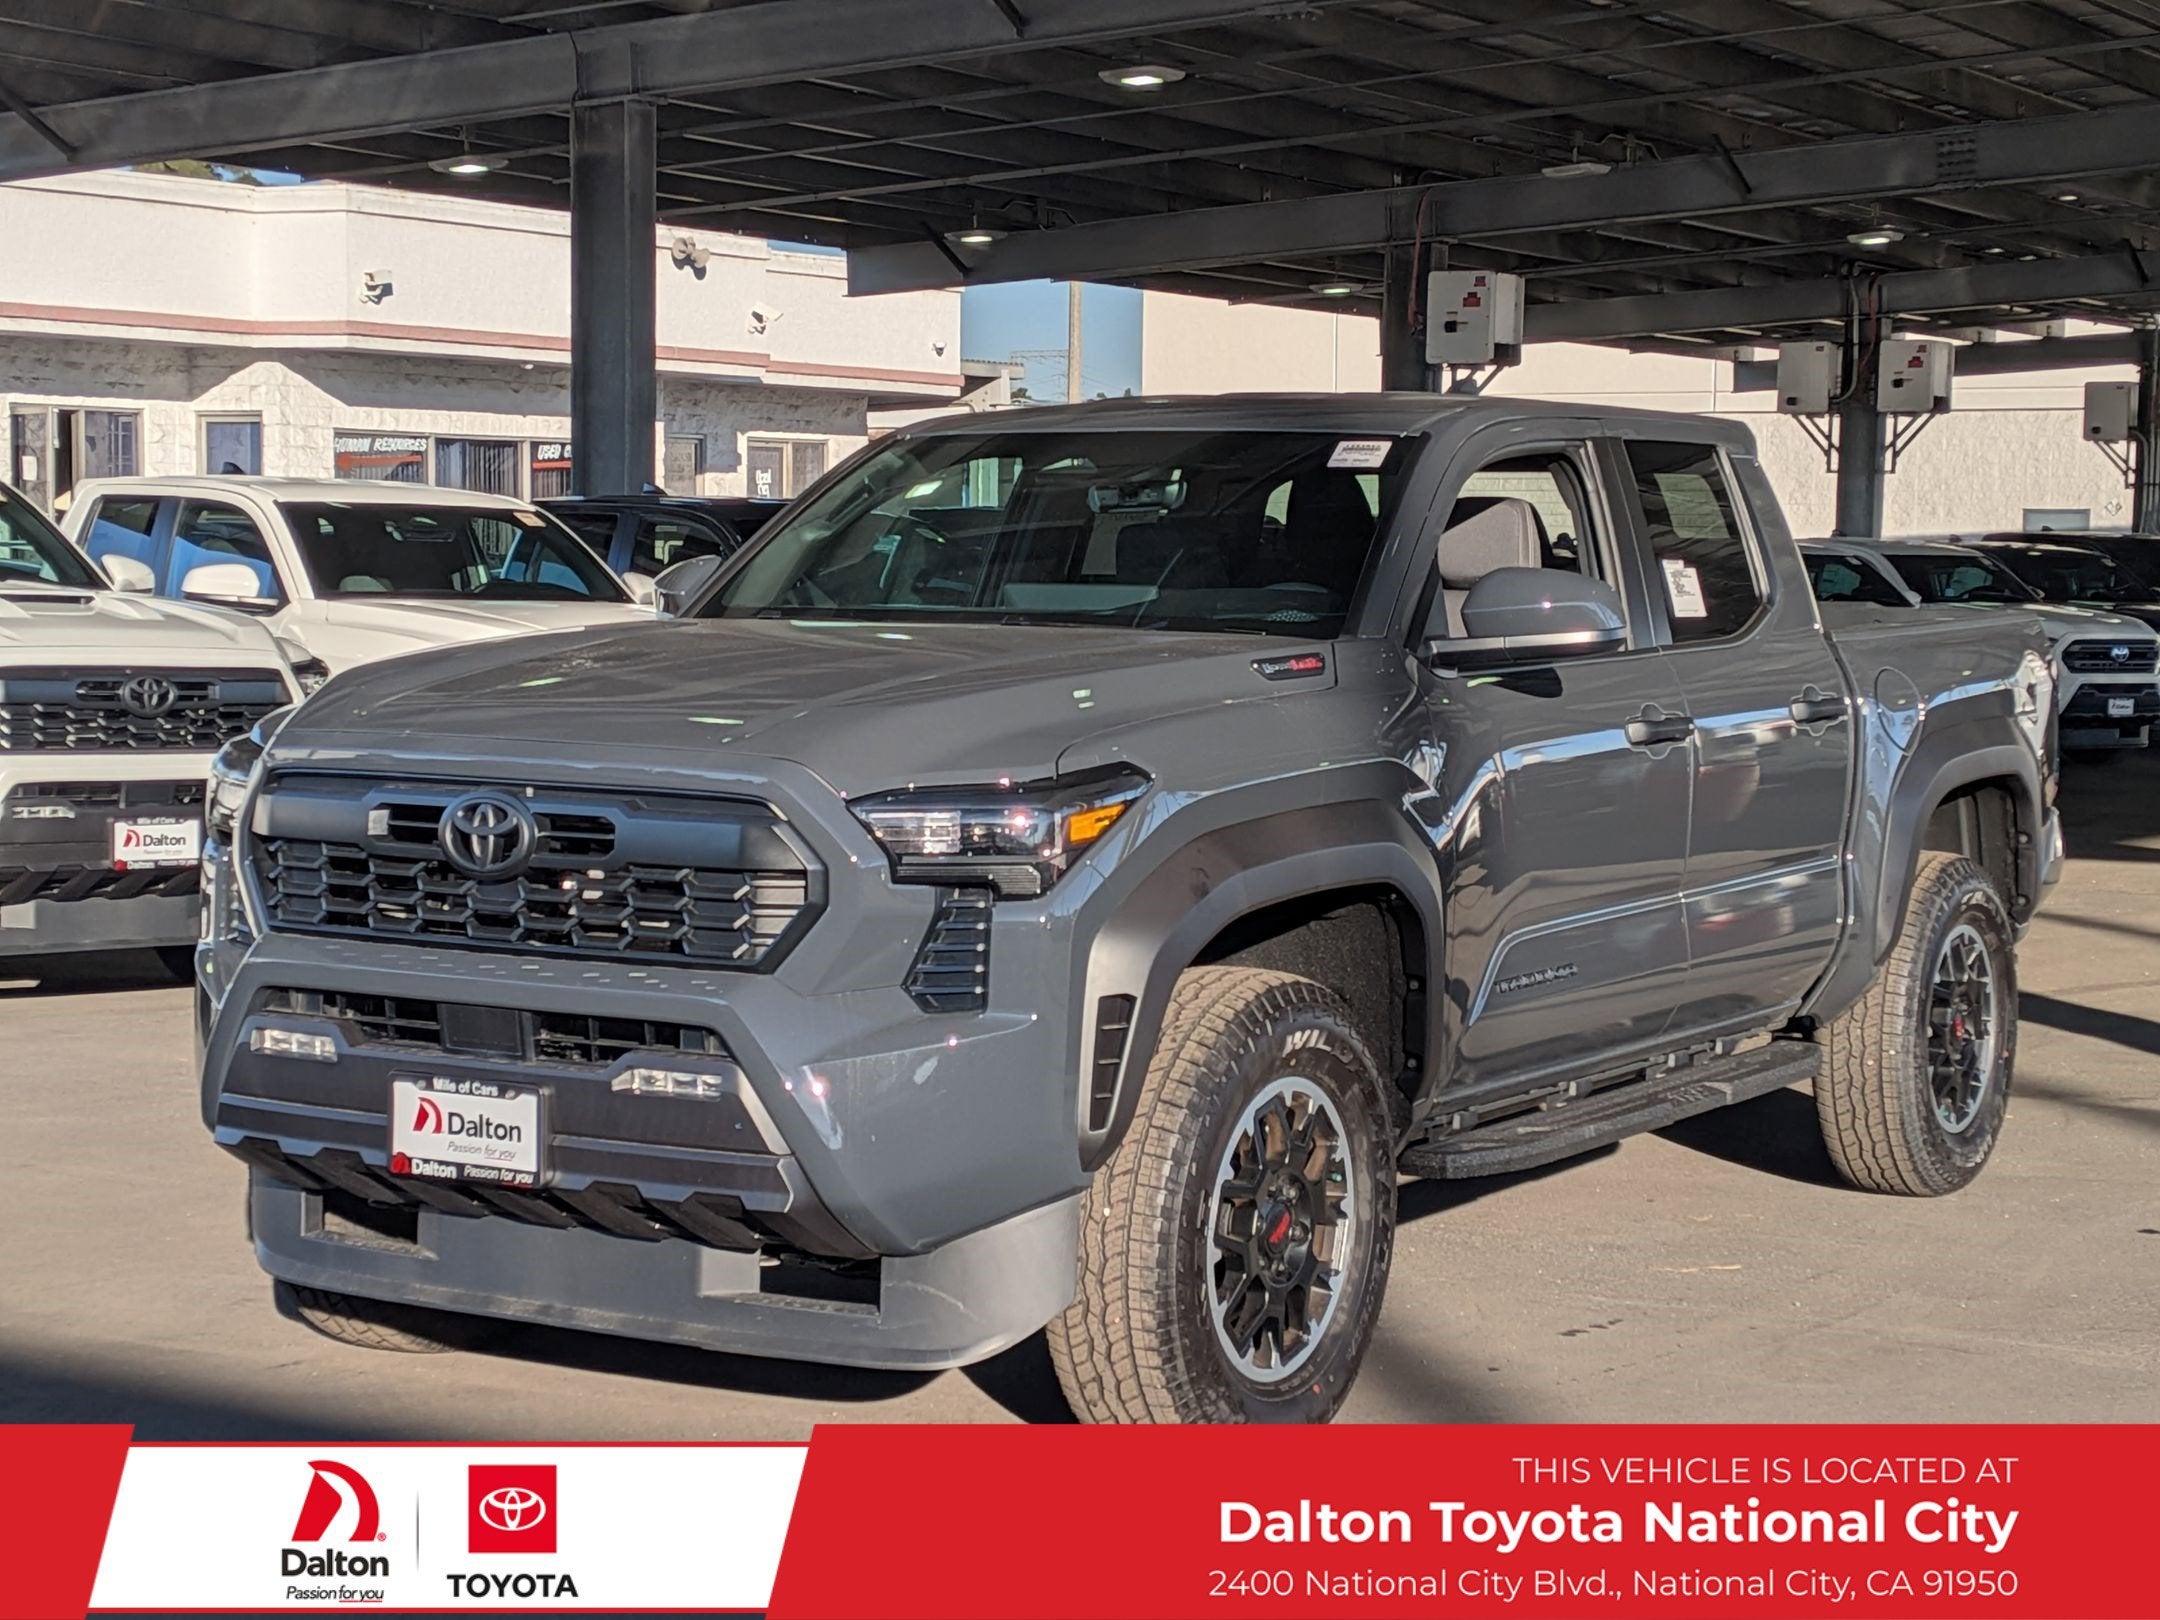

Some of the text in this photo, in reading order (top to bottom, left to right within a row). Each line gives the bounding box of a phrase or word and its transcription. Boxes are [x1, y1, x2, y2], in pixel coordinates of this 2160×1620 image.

[373, 437, 427, 452] RESOURCES
[538, 444, 561, 460] USED
[143, 834, 186, 847] Dalton
[433, 1077, 498, 1097] Mile of Cars
[448, 1112, 521, 1143] Dalton
[447, 1141, 482, 1155] Passion
[412, 1159, 457, 1179] Dalton
[464, 1165, 499, 1179] Passion
